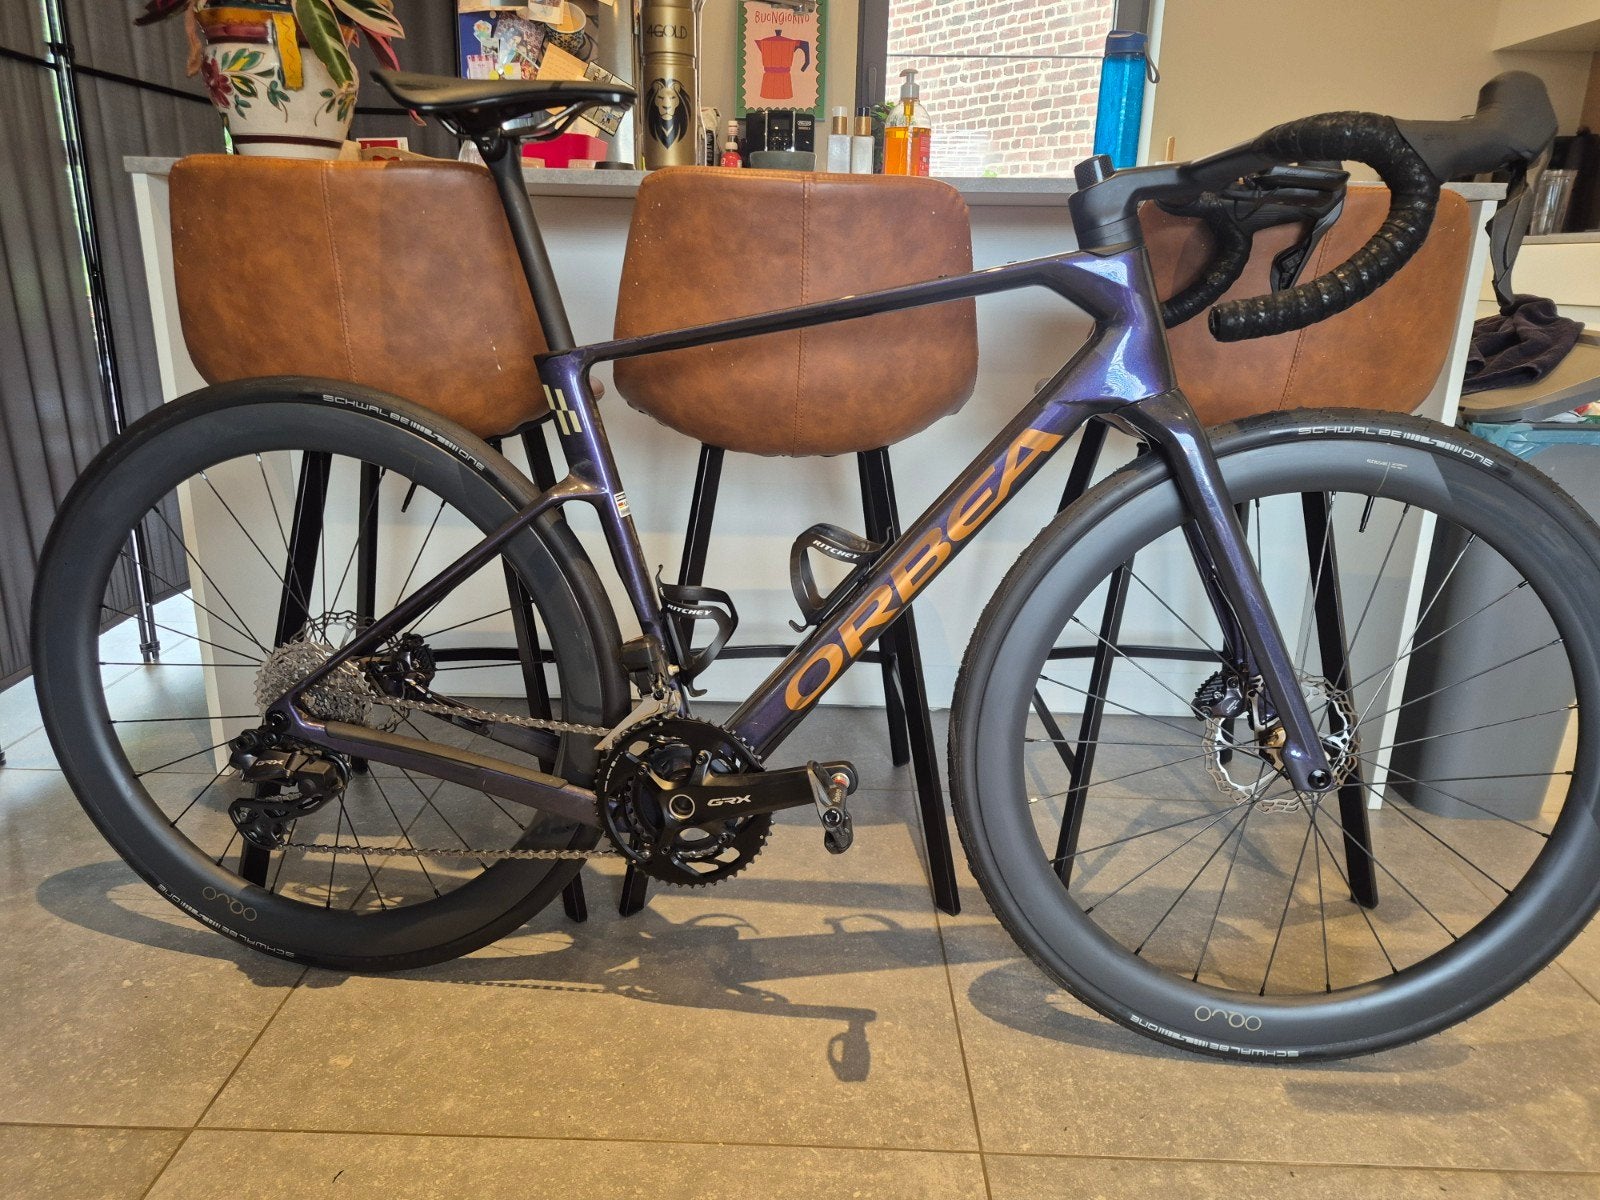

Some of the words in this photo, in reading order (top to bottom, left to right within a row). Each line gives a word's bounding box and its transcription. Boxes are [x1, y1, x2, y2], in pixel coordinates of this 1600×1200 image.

[646, 24, 688, 40] 4GOLD
[322, 393, 410, 425] SCHWALBE
[458, 448, 485, 472] ONE
[1298, 425, 1402, 438] SCHWALBE
[1461, 448, 1494, 468] ONE
[812, 539, 861, 559] RITCHEY
[784, 427, 1064, 712] ORBEA
[666, 603, 713, 616] RITCHEY
[706, 794, 752, 807] GRX
[221, 925, 296, 958] SCHWALBE
[1129, 1014, 1159, 1032] ONE
[1209, 1041, 1300, 1058] SCHWALBE
